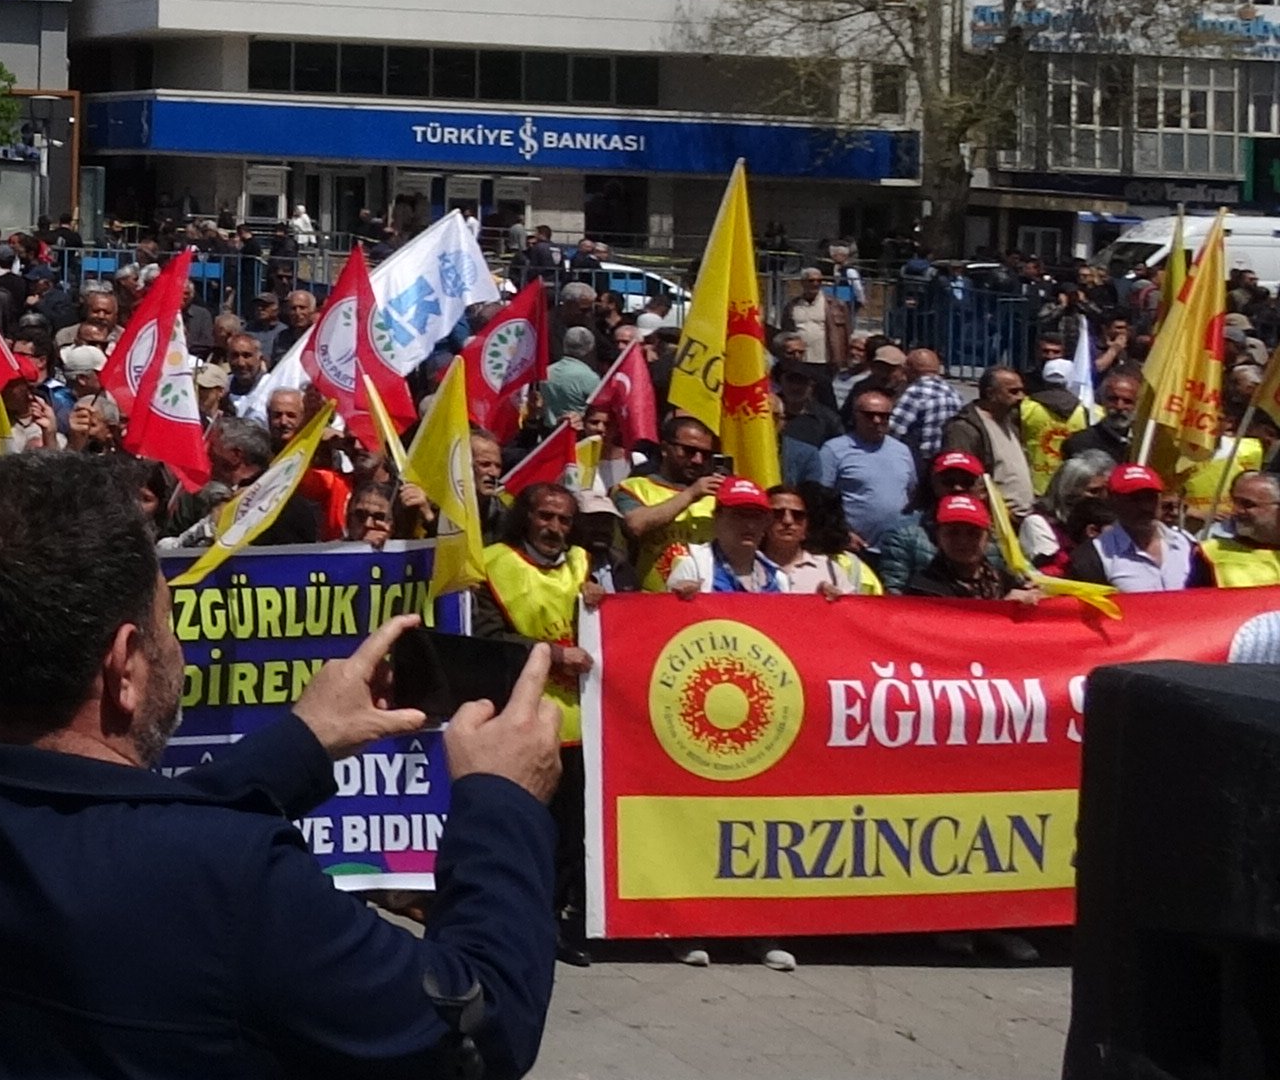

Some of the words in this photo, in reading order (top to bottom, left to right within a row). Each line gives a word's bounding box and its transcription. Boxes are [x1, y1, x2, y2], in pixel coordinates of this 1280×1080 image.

[411, 122, 514, 146] TÜRKİYE
[542, 131, 645, 152] BANKASI
[168, 573, 358, 641] ZGÜRLÜK
[659, 631, 739, 690] EĞİTİM
[746, 643, 794, 688] SEN
[826, 661, 1048, 748] EĞİTİM
[715, 804, 1052, 880] ERZİNCAN
